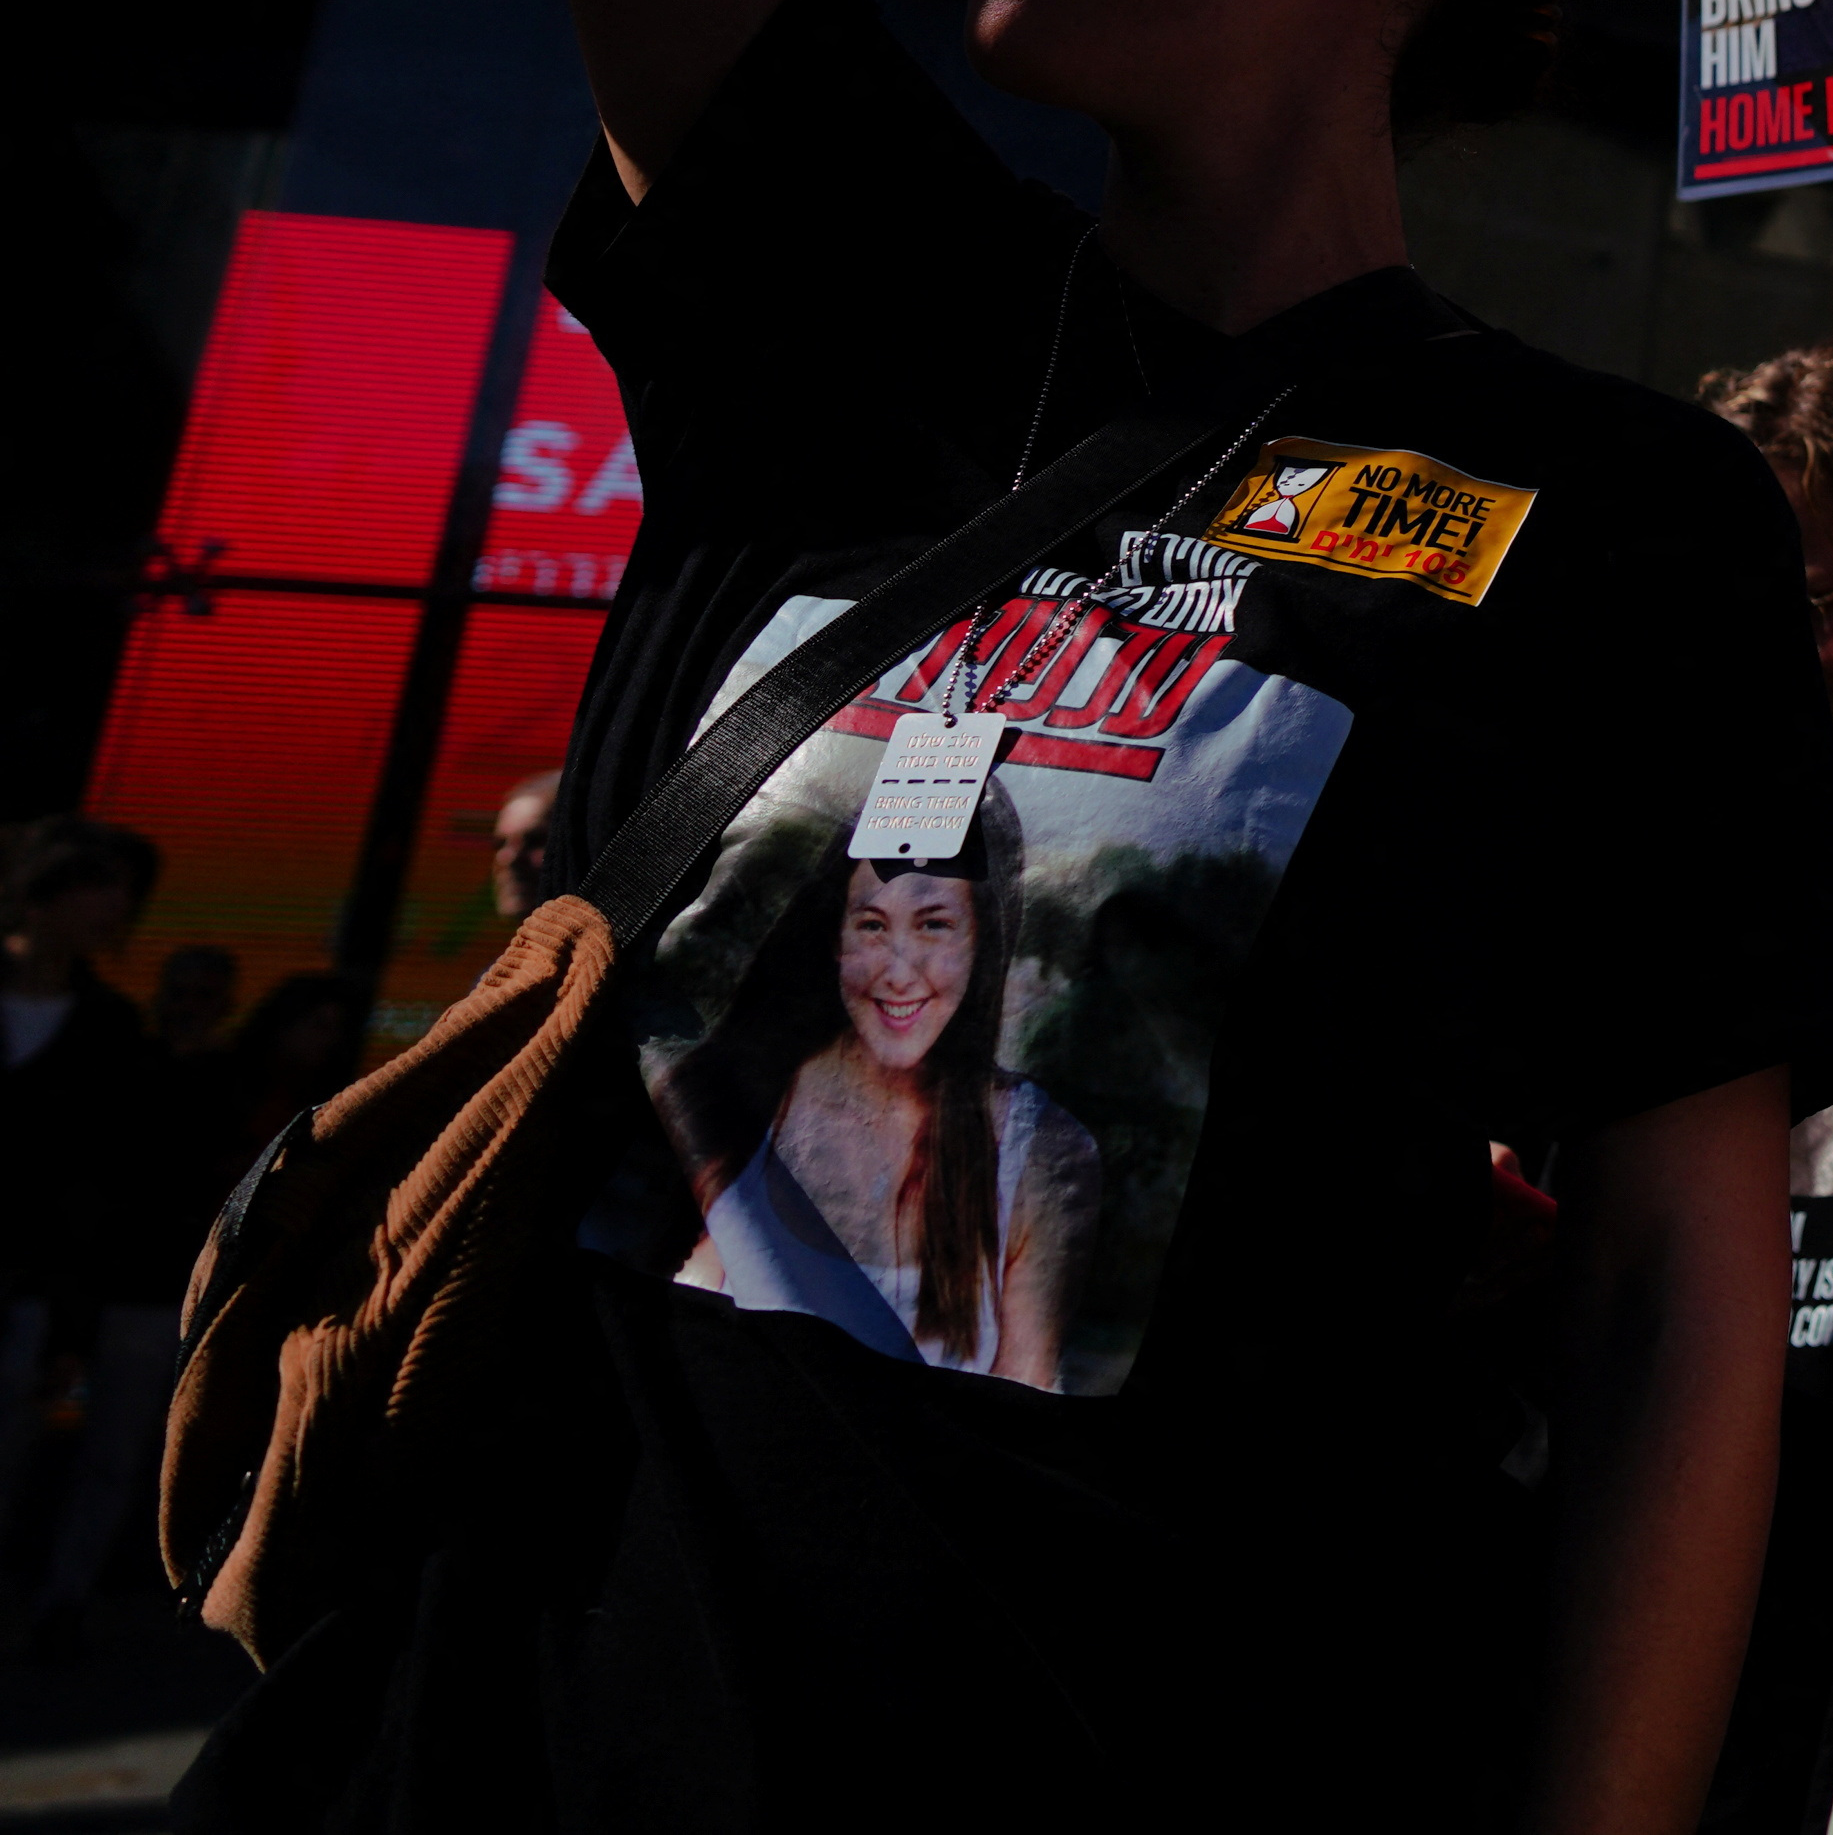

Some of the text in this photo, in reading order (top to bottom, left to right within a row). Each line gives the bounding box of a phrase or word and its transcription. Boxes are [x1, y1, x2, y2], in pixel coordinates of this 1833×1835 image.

[1700, 18, 1778, 91] HIM
[1699, 80, 1816, 156] HOME
[1342, 487, 1484, 557] TIME!
[1353, 464, 1496, 522] NO MORE
[1310, 530, 1471, 585] 105 ימים
[947, 732, 982, 748] הלב
[874, 796, 971, 809] BRING THEM
